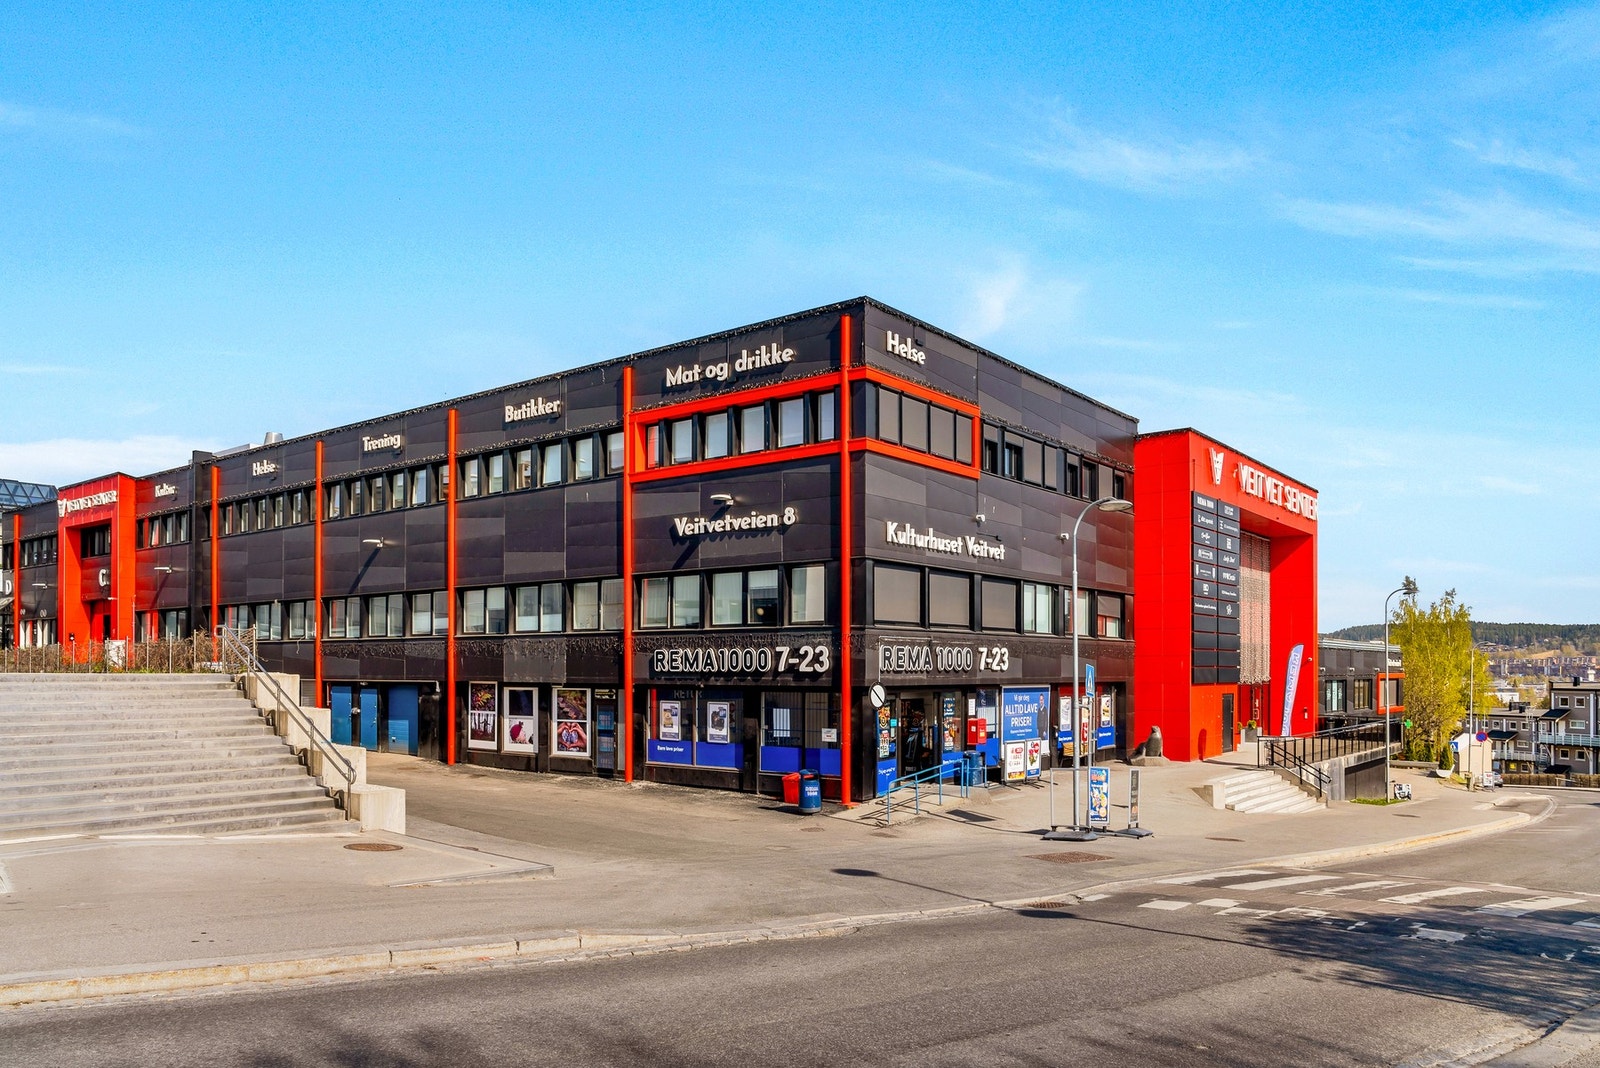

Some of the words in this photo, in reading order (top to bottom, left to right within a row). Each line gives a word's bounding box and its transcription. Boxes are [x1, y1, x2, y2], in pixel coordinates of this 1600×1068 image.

[886, 330, 926, 365] Helse
[666, 365, 701, 387] Mat
[705, 361, 728, 381] og
[735, 343, 793, 373] drikke
[504, 397, 560, 423] Butikker
[363, 433, 401, 451] Trening
[1238, 462, 1284, 506] VEITVET
[674, 511, 779, 536] Veitvetveien
[783, 507, 796, 525] 8
[886, 521, 963, 554] Kulturhuset
[965, 535, 1006, 560] Veitvet
[653, 647, 718, 672] REMA
[718, 648, 772, 672] 1000
[775, 645, 830, 673] 7-23
[880, 644, 933, 671] REMA
[936, 646, 973, 671] 1000
[978, 647, 1009, 671] 7-23
[1005, 704, 1024, 715] ALLTID
[1024, 703, 1038, 714] LAVE
[1011, 716, 1032, 727] PRISER!
